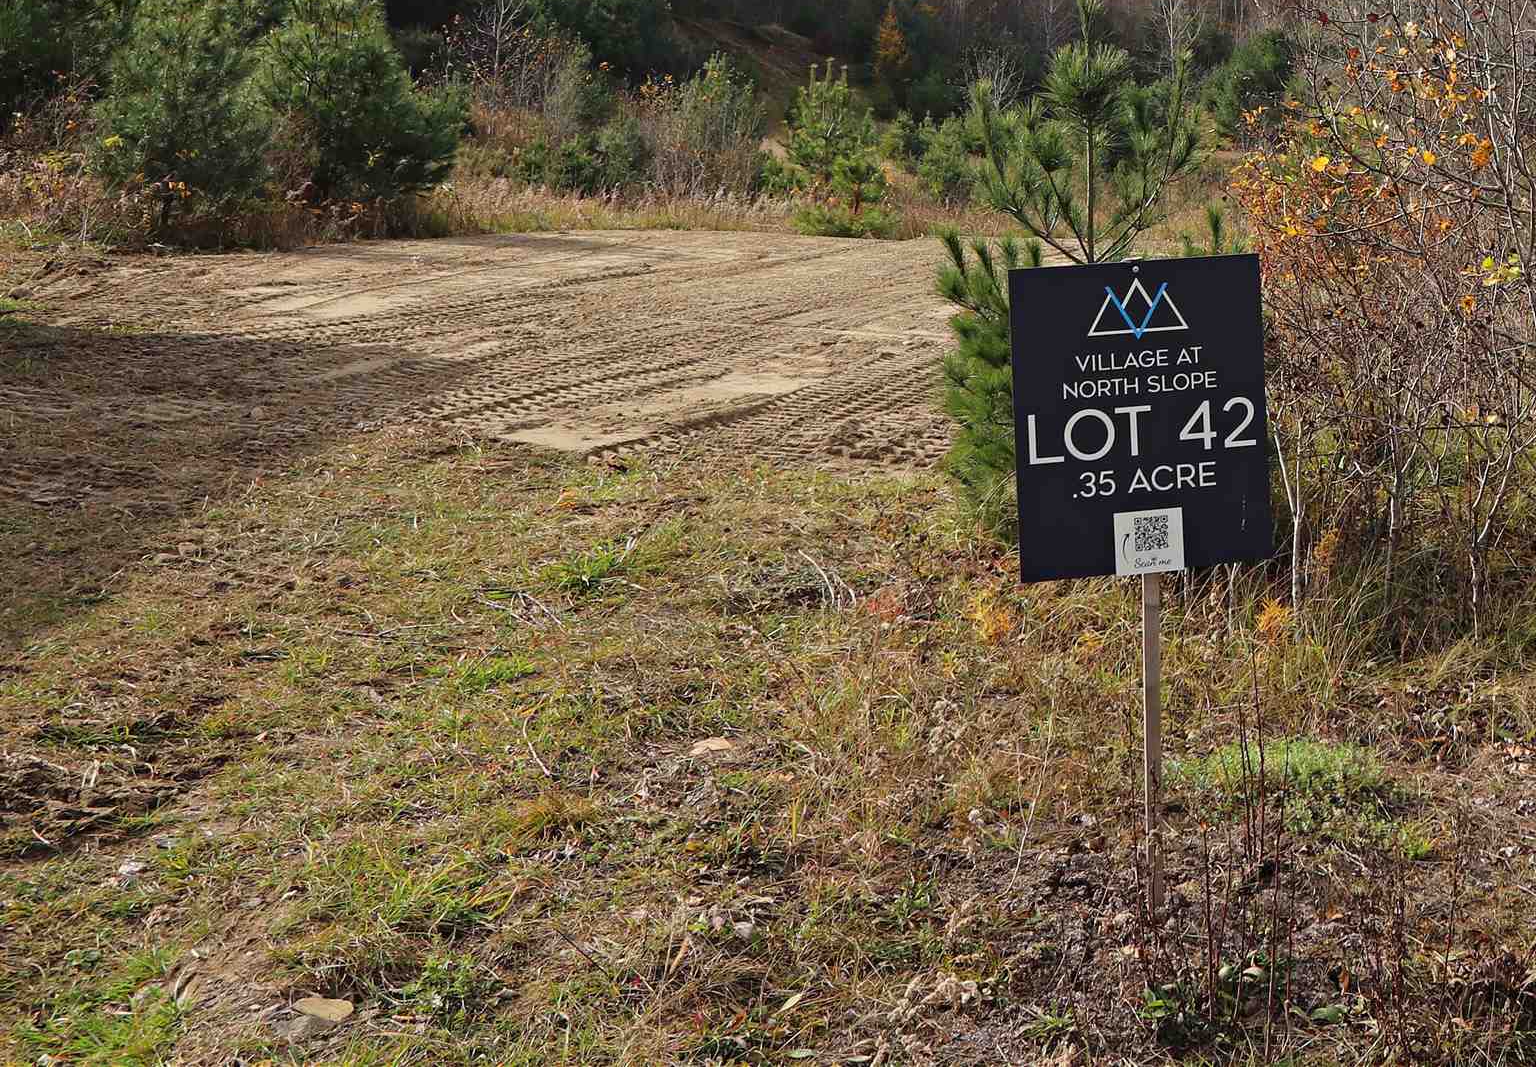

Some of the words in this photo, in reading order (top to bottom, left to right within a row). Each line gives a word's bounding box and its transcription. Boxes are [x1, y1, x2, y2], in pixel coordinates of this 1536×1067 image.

[1075, 349, 1169, 372] VILLAGE
[1176, 346, 1203, 364] AT
[1062, 377, 1140, 400] NORTH
[1147, 371, 1217, 393] SLOPE
[1027, 405, 1151, 465] LOT
[1179, 396, 1257, 451] 42
[1072, 470, 1116, 499] .35
[1128, 461, 1217, 494] ACRE
